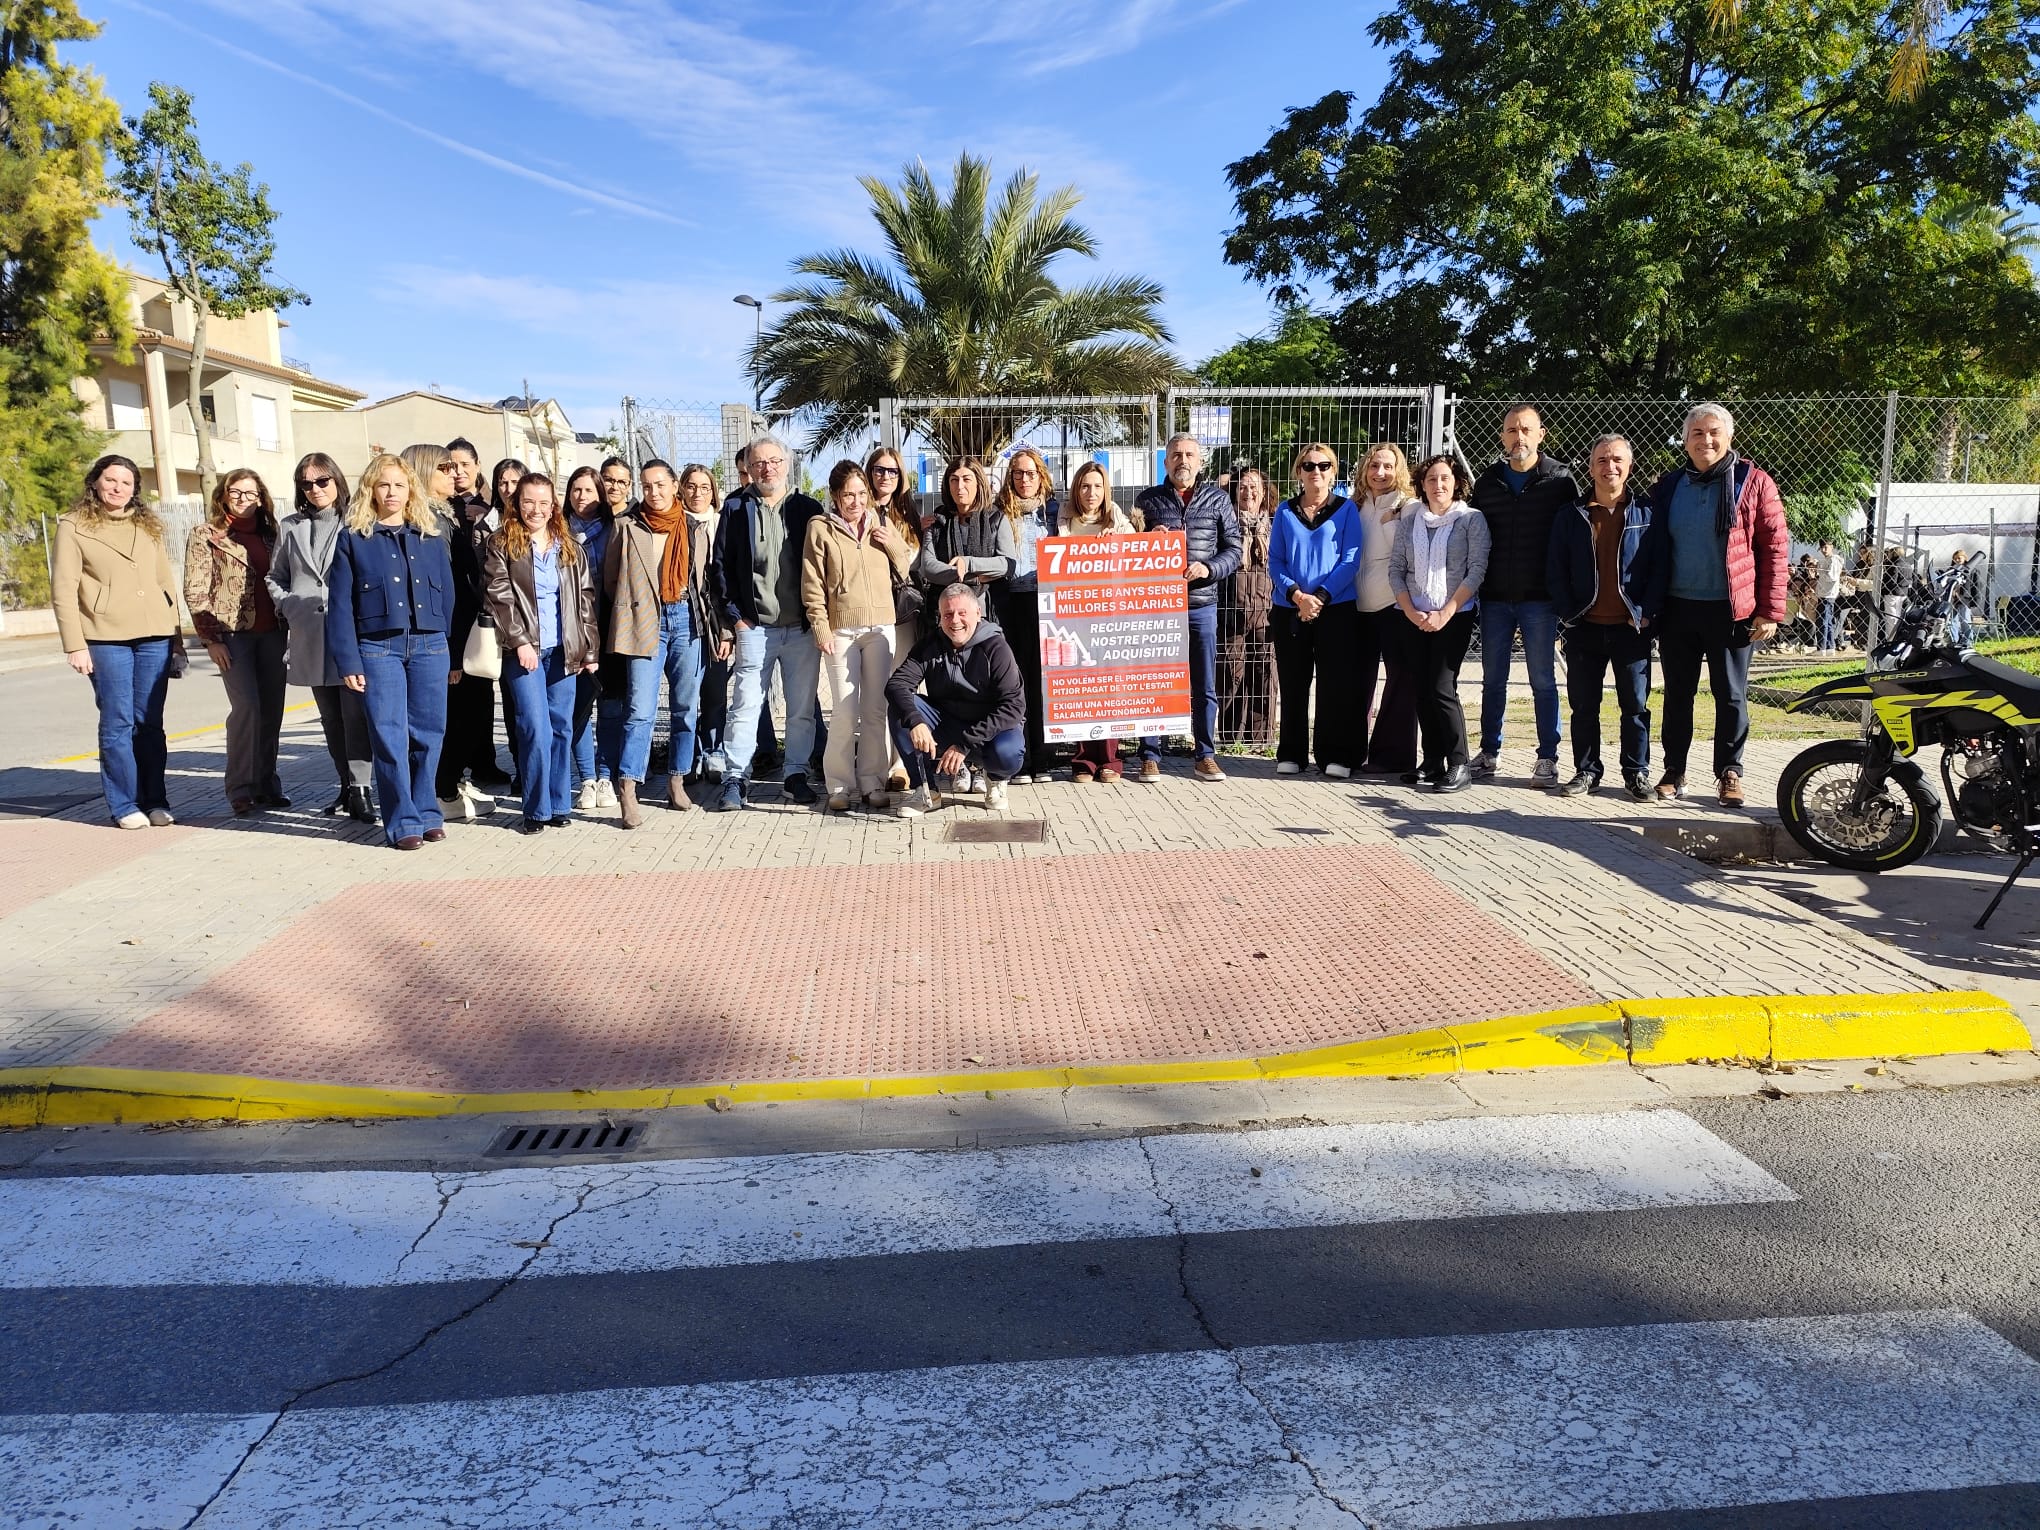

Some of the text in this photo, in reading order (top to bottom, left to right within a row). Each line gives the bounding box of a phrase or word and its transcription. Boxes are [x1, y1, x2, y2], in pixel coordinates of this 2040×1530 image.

[1069, 538, 1181, 556] RAONS PER A LA
[1044, 544, 1066, 574] 7
[1067, 552, 1182, 574] MOBILITZACIÓ
[1057, 584, 1184, 600] MÉS DE 18 ANYS SENSE
[1042, 594, 1051, 612] 1
[1058, 598, 1184, 614] MILLORES SALARIALS
[1090, 619, 1181, 634] RECUPEREM EL
[1090, 632, 1182, 647] NOSTRE PODER
[1103, 646, 1180, 661] ADQUISITIU!
[1052, 679, 1065, 687] NO
[1096, 675, 1113, 684] SER
[1114, 674, 1124, 682] EL
[1125, 671, 1185, 681] PROFESSORAT
[1052, 687, 1080, 696] PITJOR
[1081, 685, 1109, 694] PAGAT
[1110, 684, 1121, 692] DE
[1122, 683, 1138, 692] TOT
[1053, 702, 1083, 711] EXIGIM
[1084, 700, 1102, 709] UNA
[1053, 710, 1094, 719] SALARIAL
[1152, 705, 1164, 714] JA!
